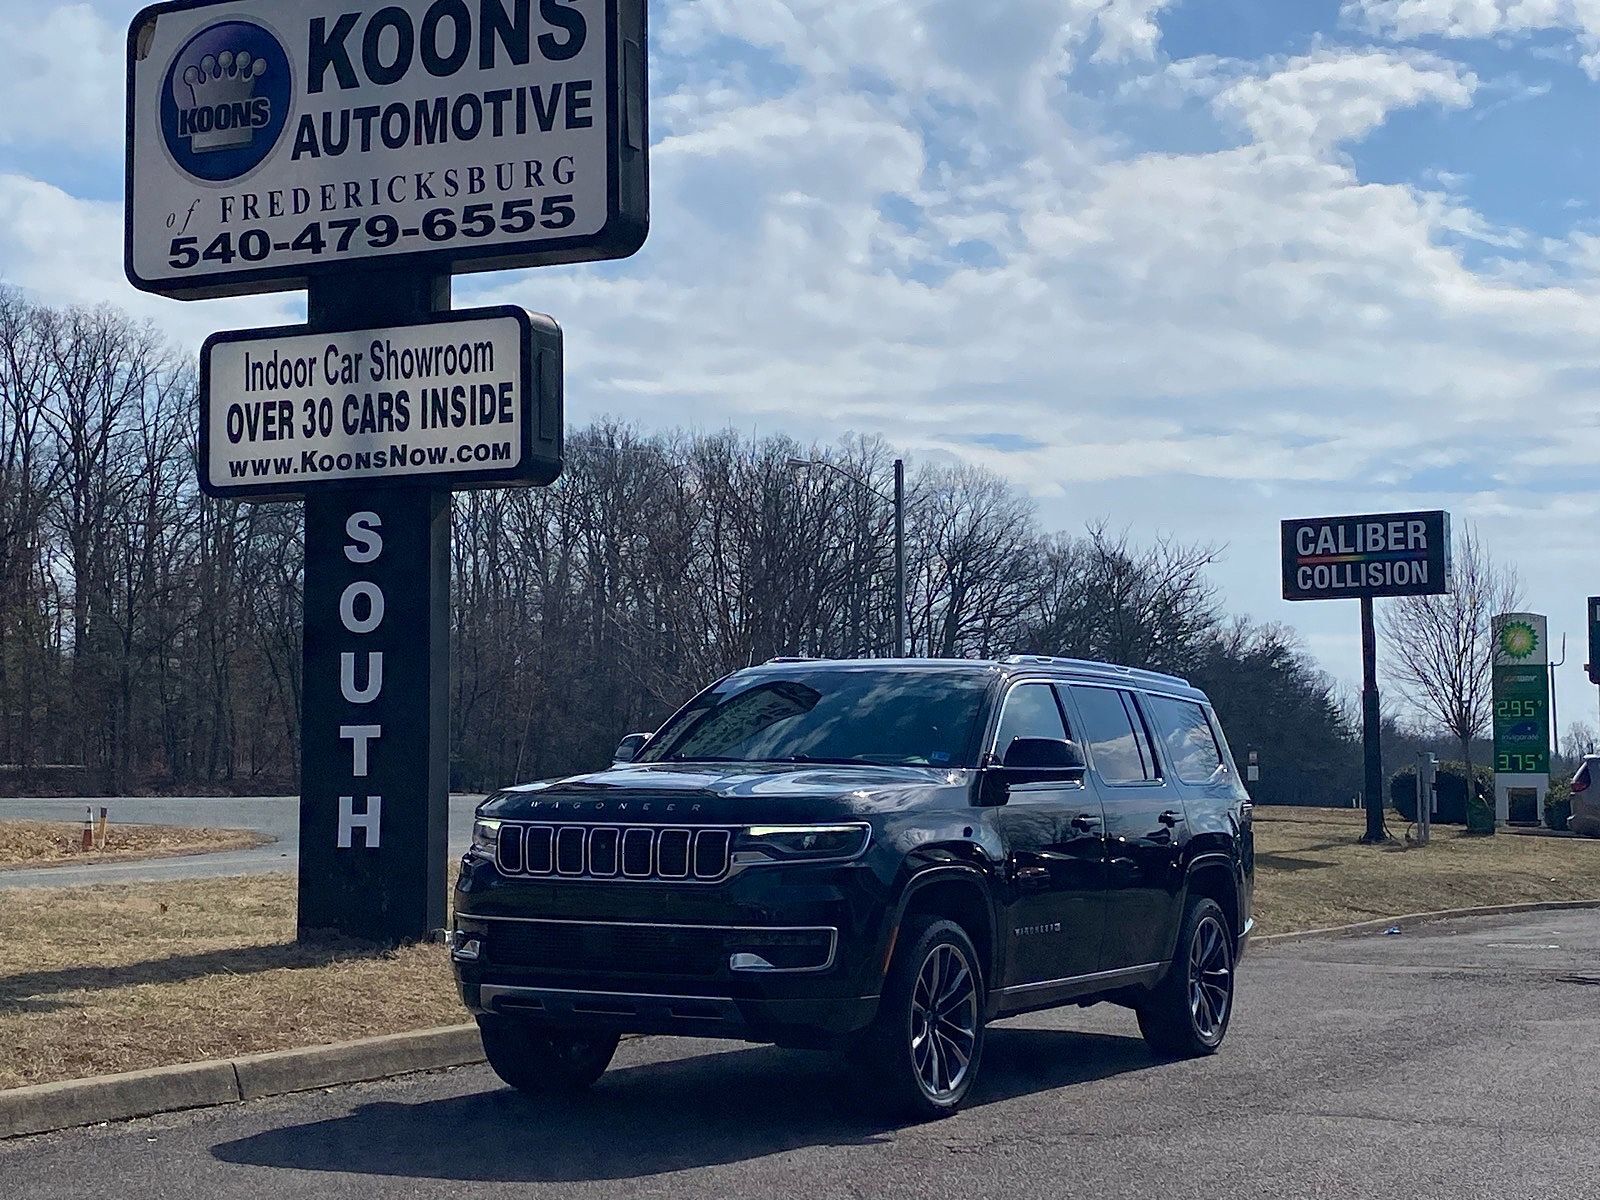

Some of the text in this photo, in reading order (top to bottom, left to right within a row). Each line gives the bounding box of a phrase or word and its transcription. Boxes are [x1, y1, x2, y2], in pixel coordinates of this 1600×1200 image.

[307, 0, 588, 95] KOONS
[179, 99, 270, 135] KOONS
[291, 80, 593, 161] AUTOMOTIVE
[166, 155, 577, 235] of FREDERICKSBURG
[168, 194, 576, 269] 540-479-6555
[244, 339, 494, 392] Indoor Car Showroom
[226, 381, 514, 444] OVER 30 CARS INSIDE
[1296, 520, 1428, 556] CALIBER
[1297, 560, 1428, 590] COLLISION
[337, 511, 385, 848] SOUTH
[530, 801, 701, 812] WAGONEER
